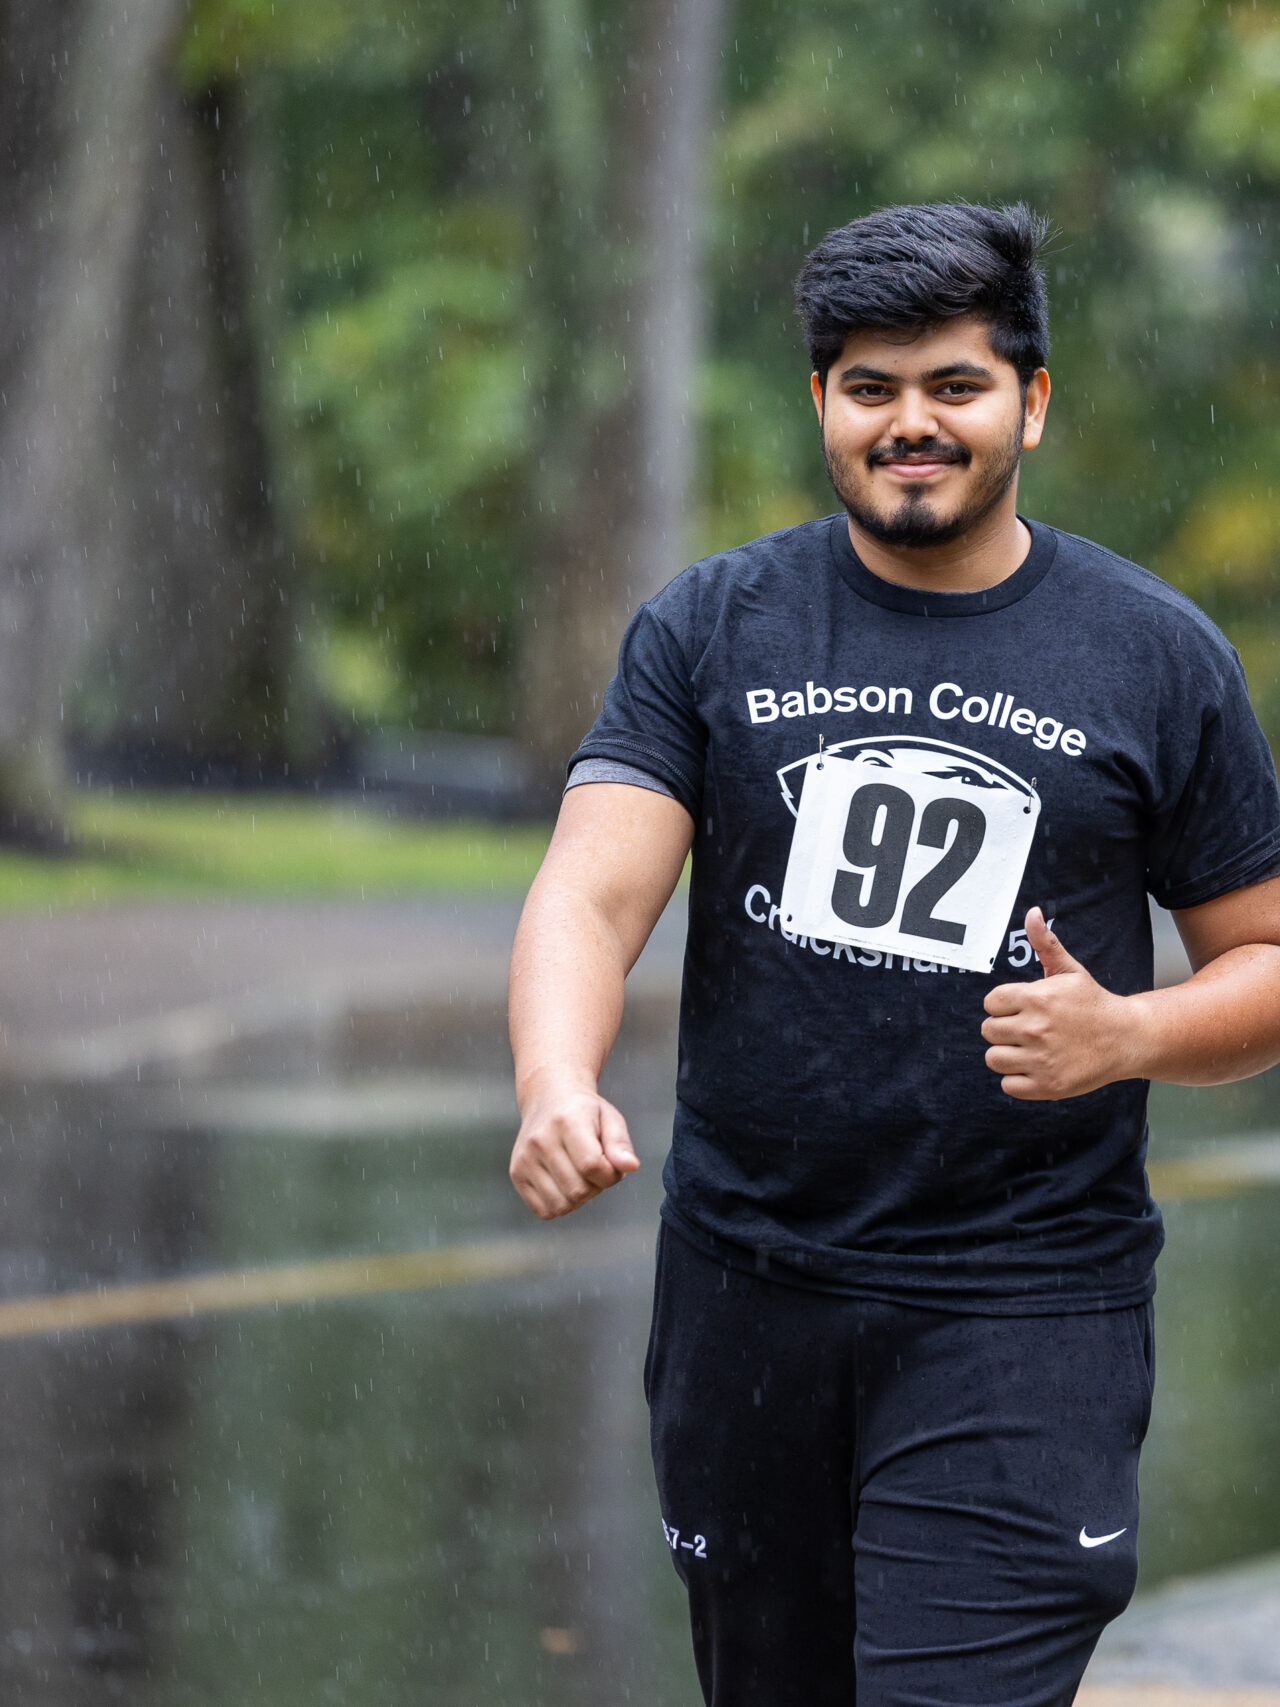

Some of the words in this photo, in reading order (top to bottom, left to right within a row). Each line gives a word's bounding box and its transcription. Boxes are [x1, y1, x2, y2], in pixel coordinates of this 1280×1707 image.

[745, 681, 914, 725] Babson
[928, 682, 1087, 757] College
[831, 783, 987, 946] 92
